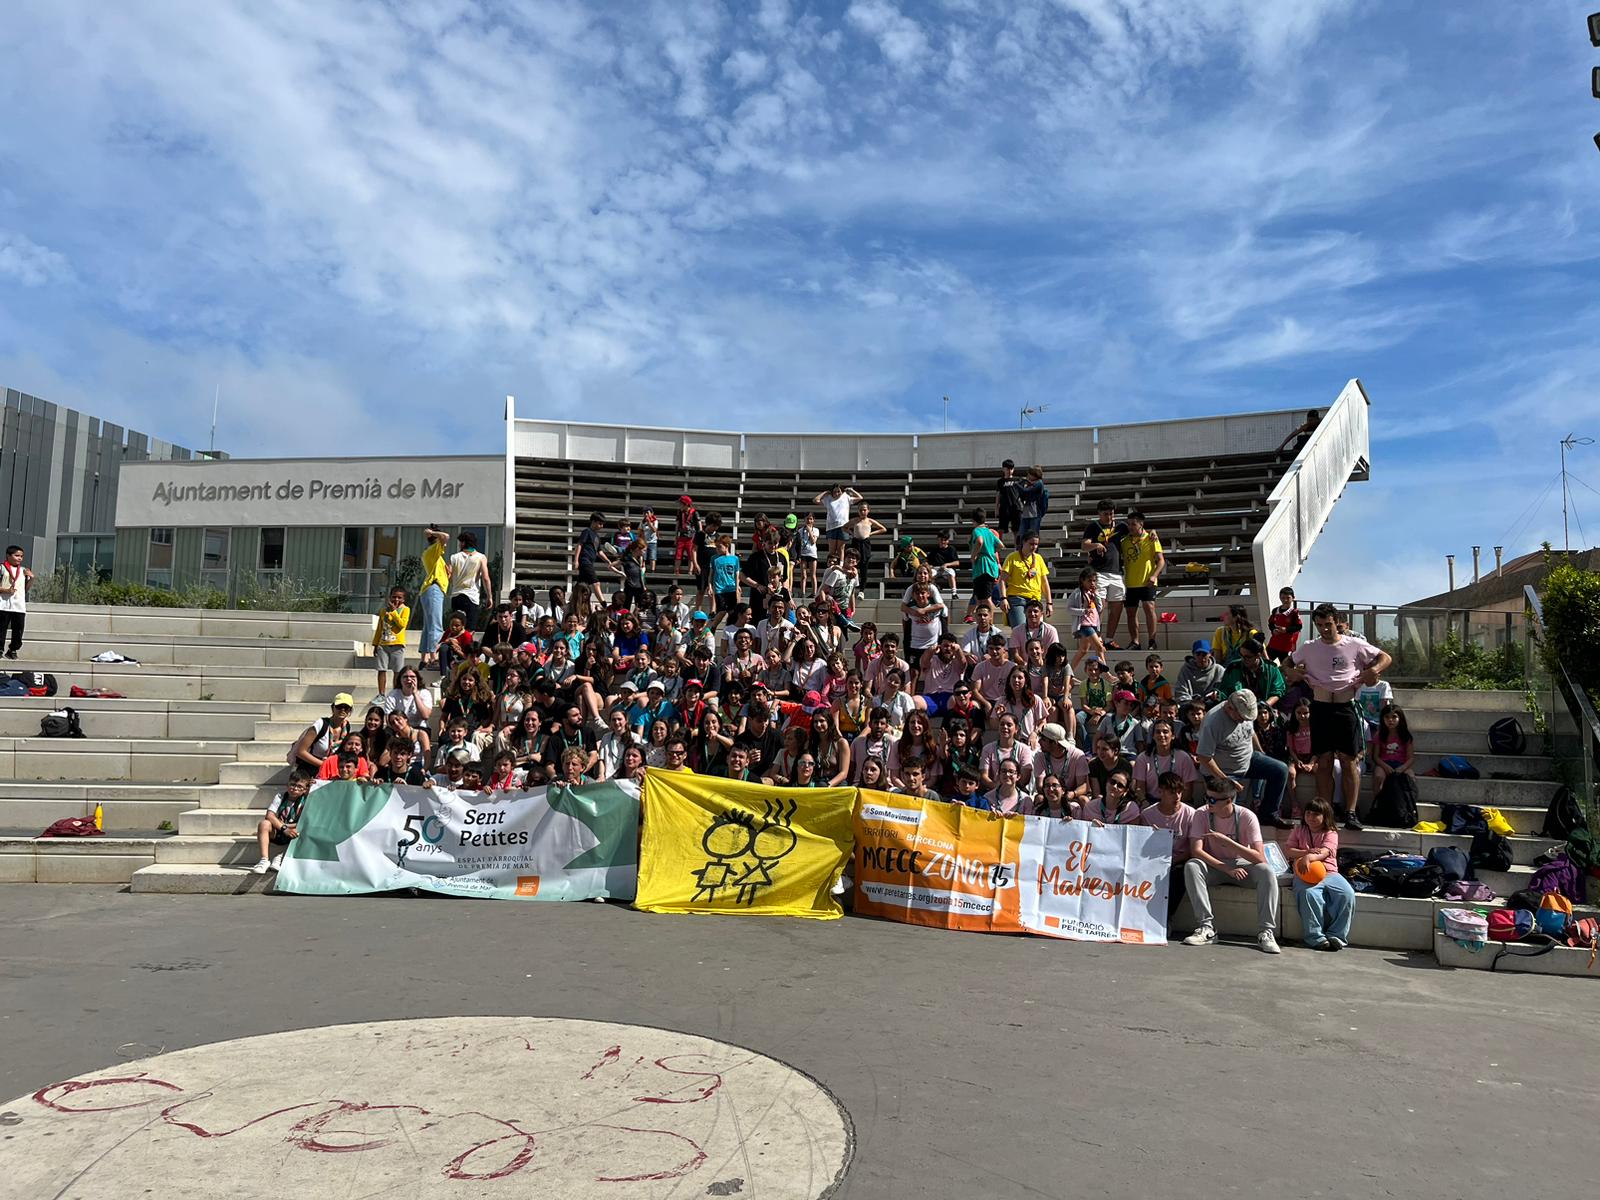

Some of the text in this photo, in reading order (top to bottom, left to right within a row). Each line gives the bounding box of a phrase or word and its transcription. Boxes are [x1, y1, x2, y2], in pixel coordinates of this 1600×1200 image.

[152, 478, 464, 506] Ajuntament de Premià de Mar
[464, 809, 506, 825] Sent
[864, 807, 919, 823] #SomMoviment
[403, 815, 444, 846] 50
[459, 829, 529, 847] Petites
[416, 843, 443, 855] anys
[906, 833, 954, 850] BARCELONA
[1065, 840, 1092, 873] El
[863, 846, 1011, 888] MCECC ZONA 15
[1037, 864, 1153, 900] Maresme
[1061, 924, 1084, 934] PERE
[1062, 918, 1104, 931] FUNDACIÓ
